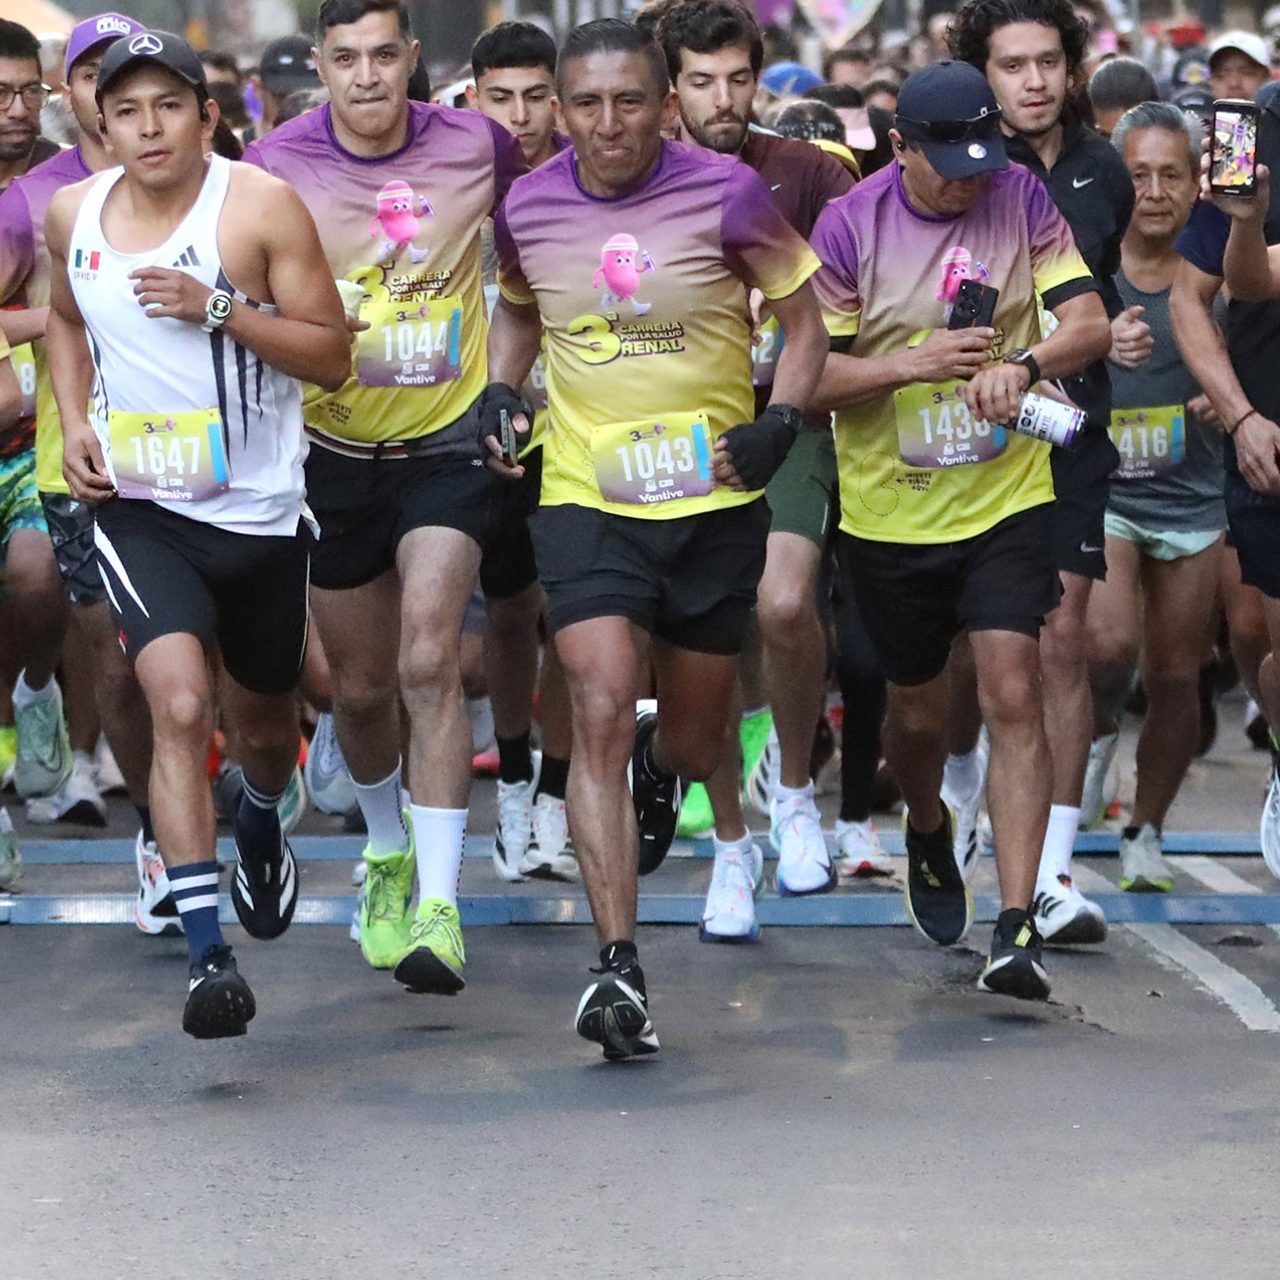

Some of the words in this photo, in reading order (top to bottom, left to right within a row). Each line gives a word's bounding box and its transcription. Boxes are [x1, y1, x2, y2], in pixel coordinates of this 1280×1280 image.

[390, 270, 452, 286] CARRERA
[390, 285, 409, 294] POR
[620, 321, 682, 333] CARRERA
[380, 320, 449, 362] 1044
[620, 333, 639, 341] POR
[640, 332, 652, 340] LA
[654, 330, 683, 339] SALUD
[621, 339, 683, 355] RENAL
[394, 374, 436, 385] Vantive
[129, 435, 201, 475] 1647
[614, 436, 695, 482] 1043
[936, 453, 979, 466] Vantive
[151, 487, 193, 499] Vantive
[638, 489, 684, 504] Vantive
